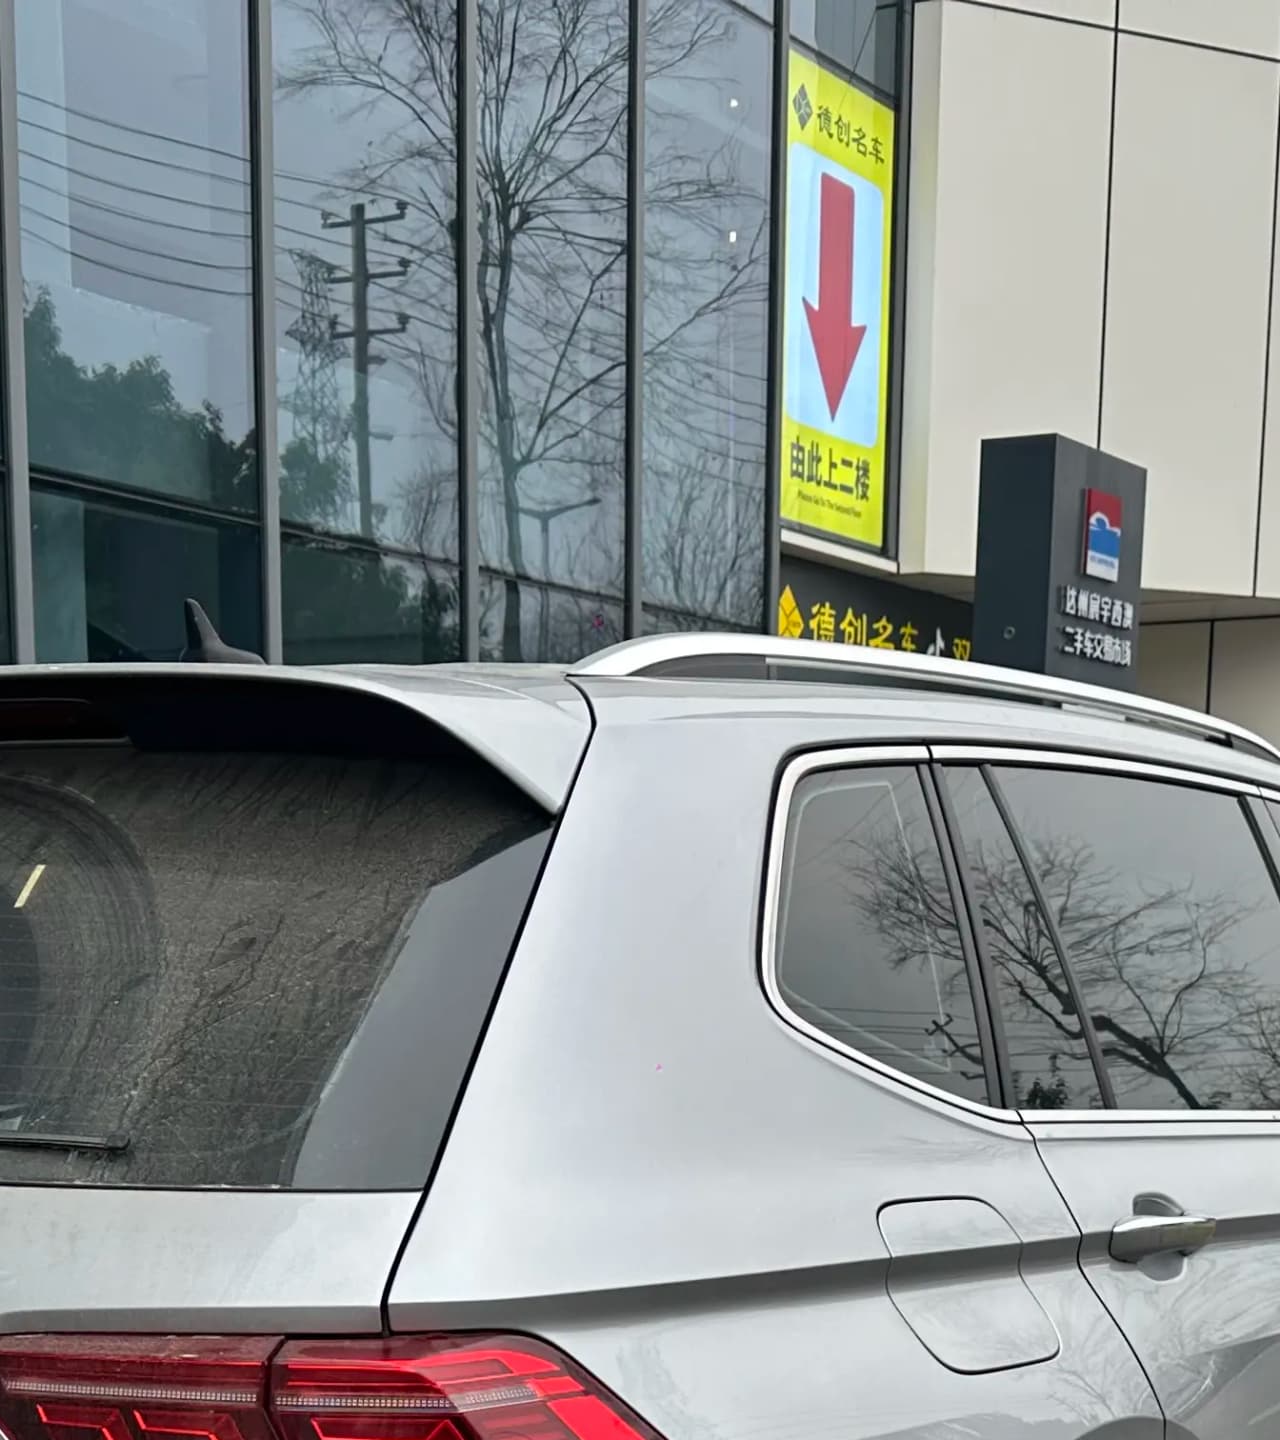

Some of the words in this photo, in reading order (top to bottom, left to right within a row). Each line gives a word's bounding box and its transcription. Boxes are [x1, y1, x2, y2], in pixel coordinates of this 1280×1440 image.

[816, 105, 885, 165] 德创名车
[789, 435, 871, 502] 由此上二楼
